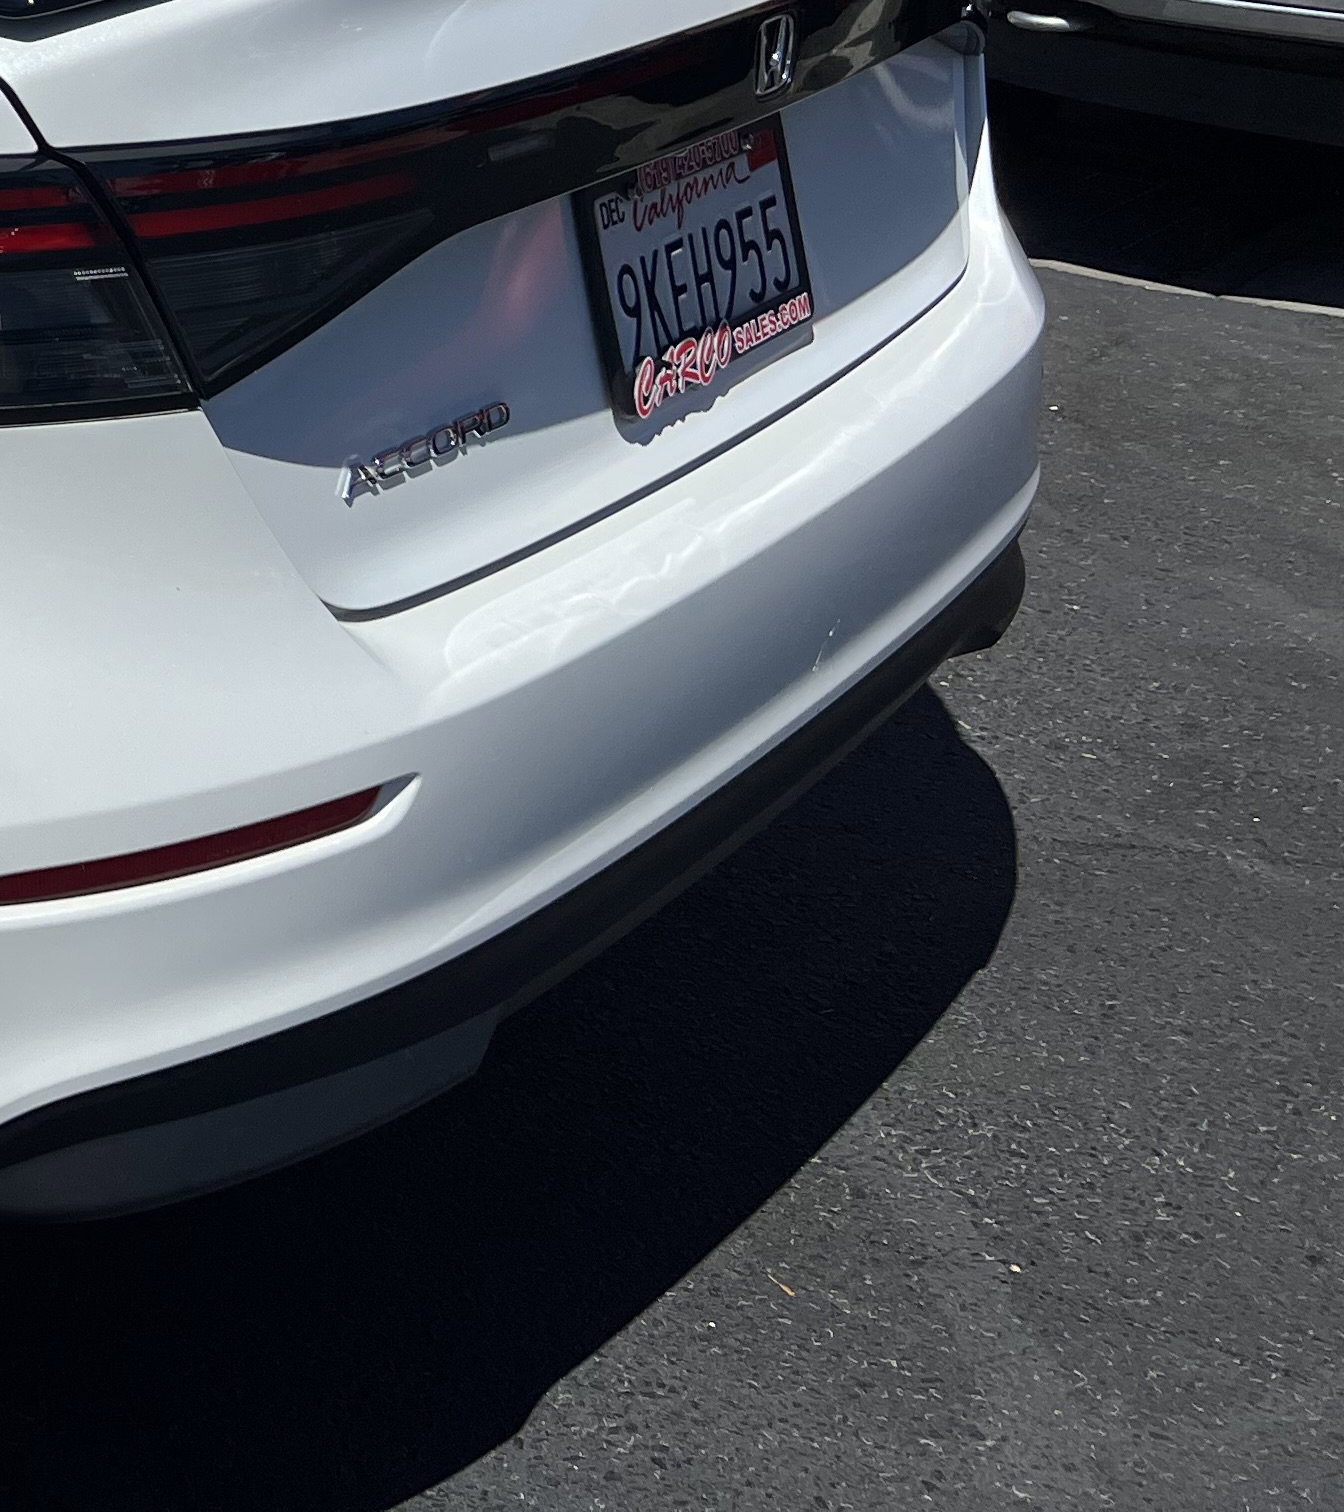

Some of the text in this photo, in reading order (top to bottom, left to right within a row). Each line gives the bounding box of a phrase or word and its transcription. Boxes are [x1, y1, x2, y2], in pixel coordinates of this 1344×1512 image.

[599, 196, 626, 230] DEC
[632, 161, 750, 233] California
[617, 194, 791, 368] 9KEH955
[633, 319, 733, 419] CARCO
[334, 400, 510, 500] ACCORD
